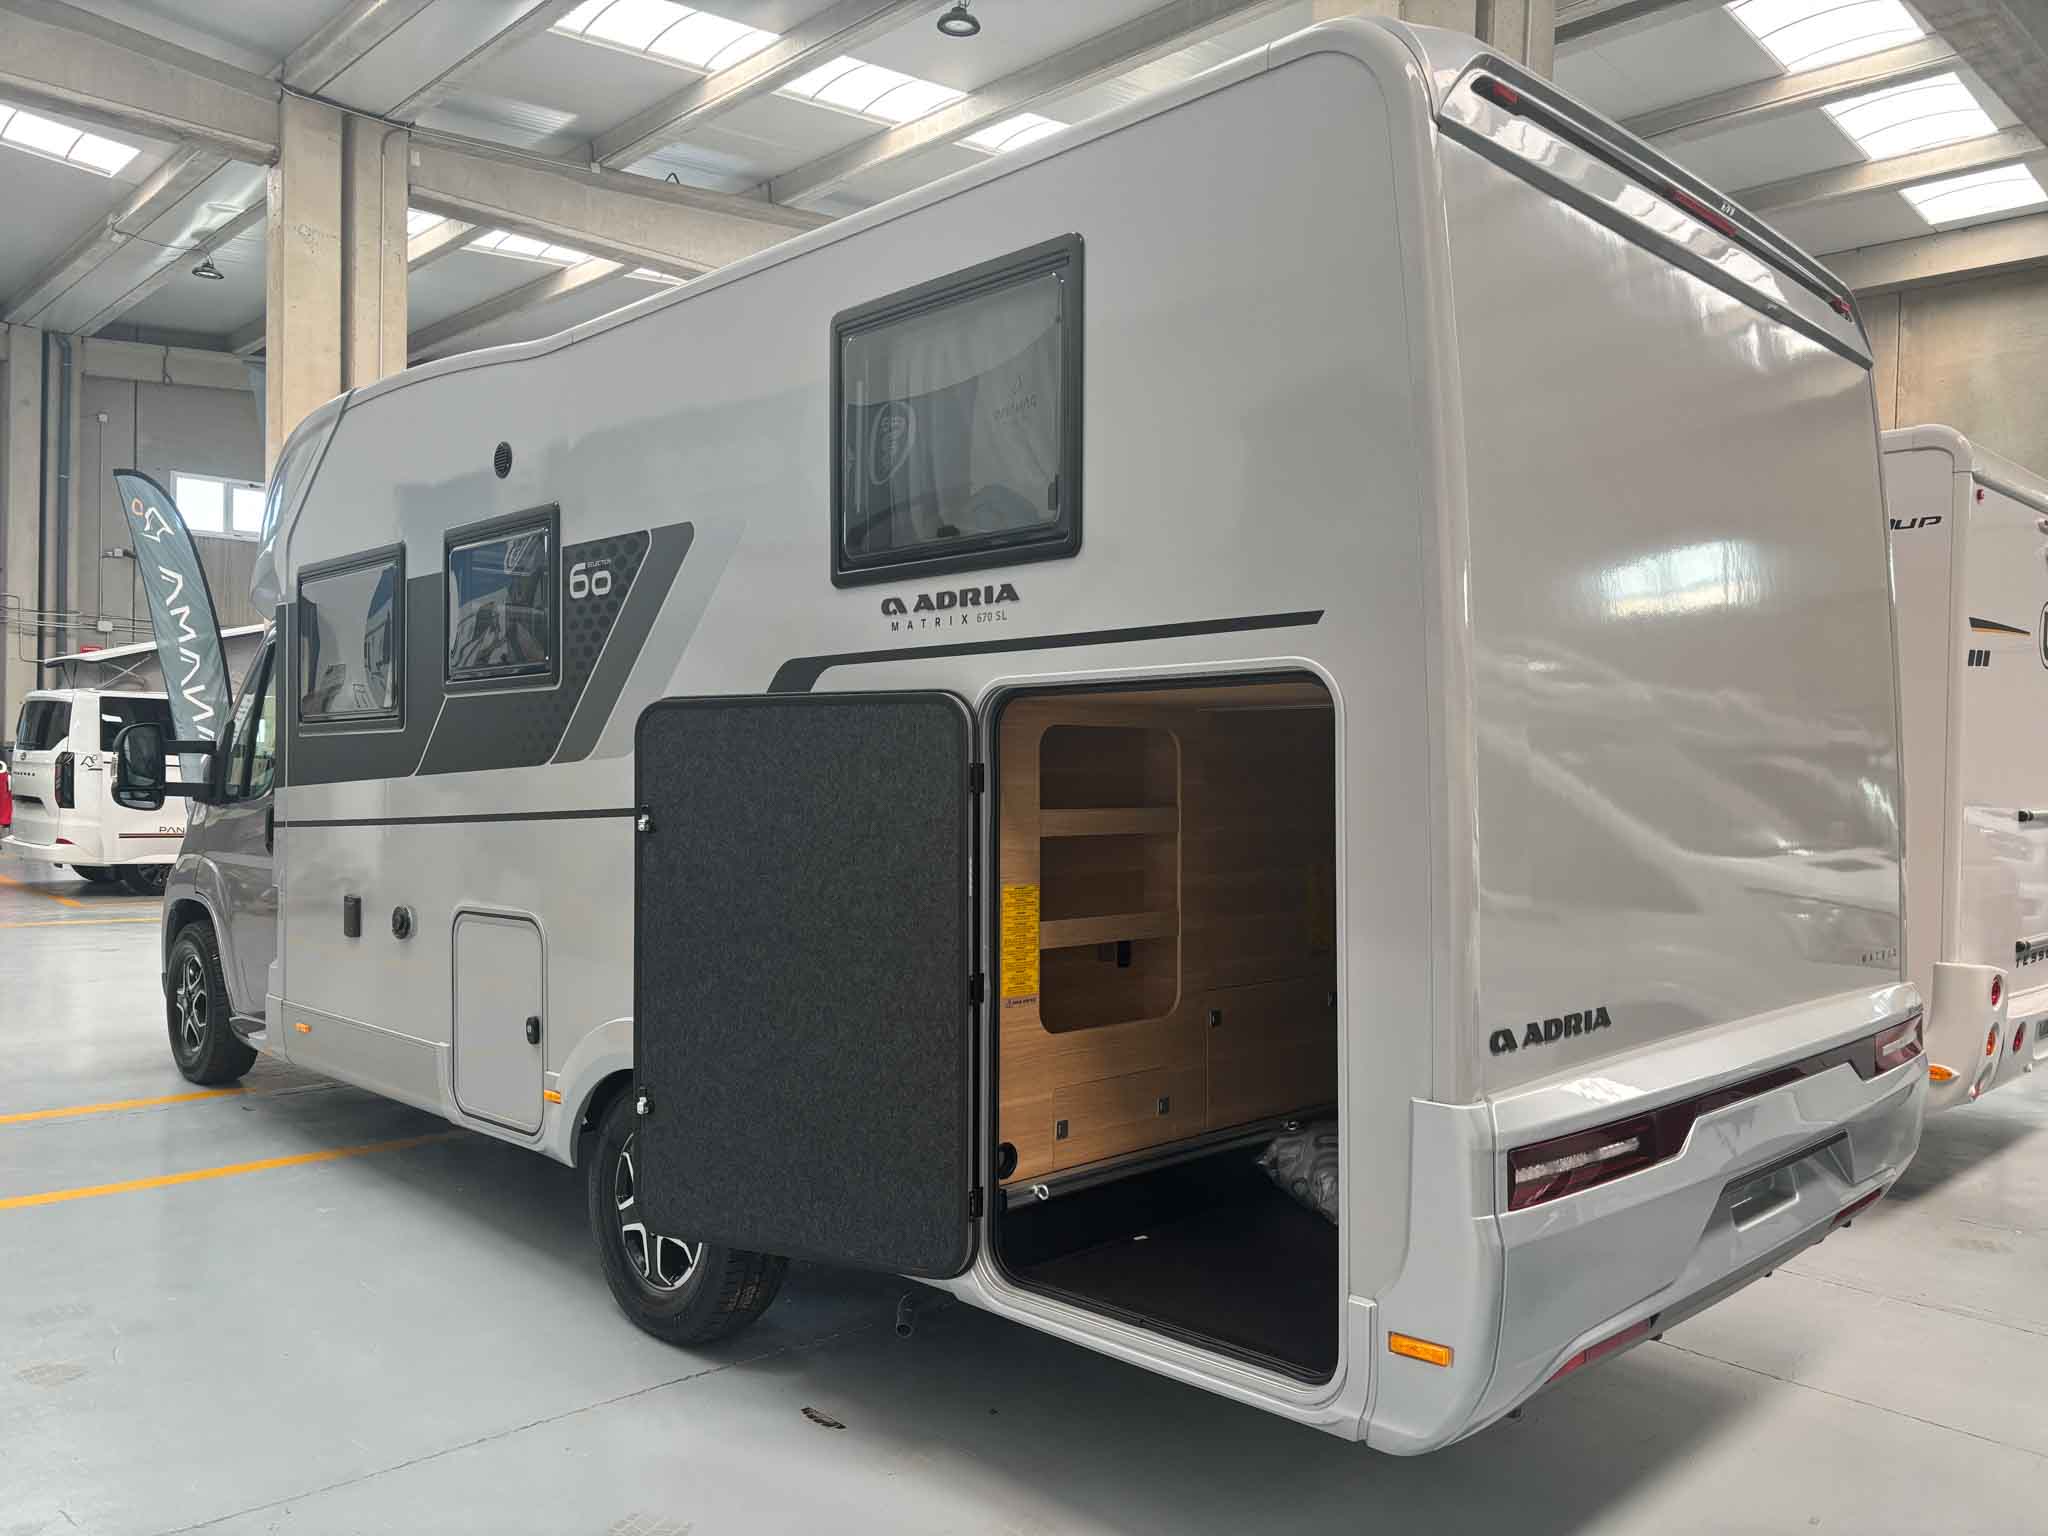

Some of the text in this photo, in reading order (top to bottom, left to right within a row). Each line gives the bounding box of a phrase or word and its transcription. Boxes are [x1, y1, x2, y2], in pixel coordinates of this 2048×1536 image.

[570, 562, 612, 600] 60
[913, 583, 1020, 613] ADRIA
[891, 609, 1008, 632] MATRIX 670 SL
[1521, 1006, 1612, 1049] ADRIA
